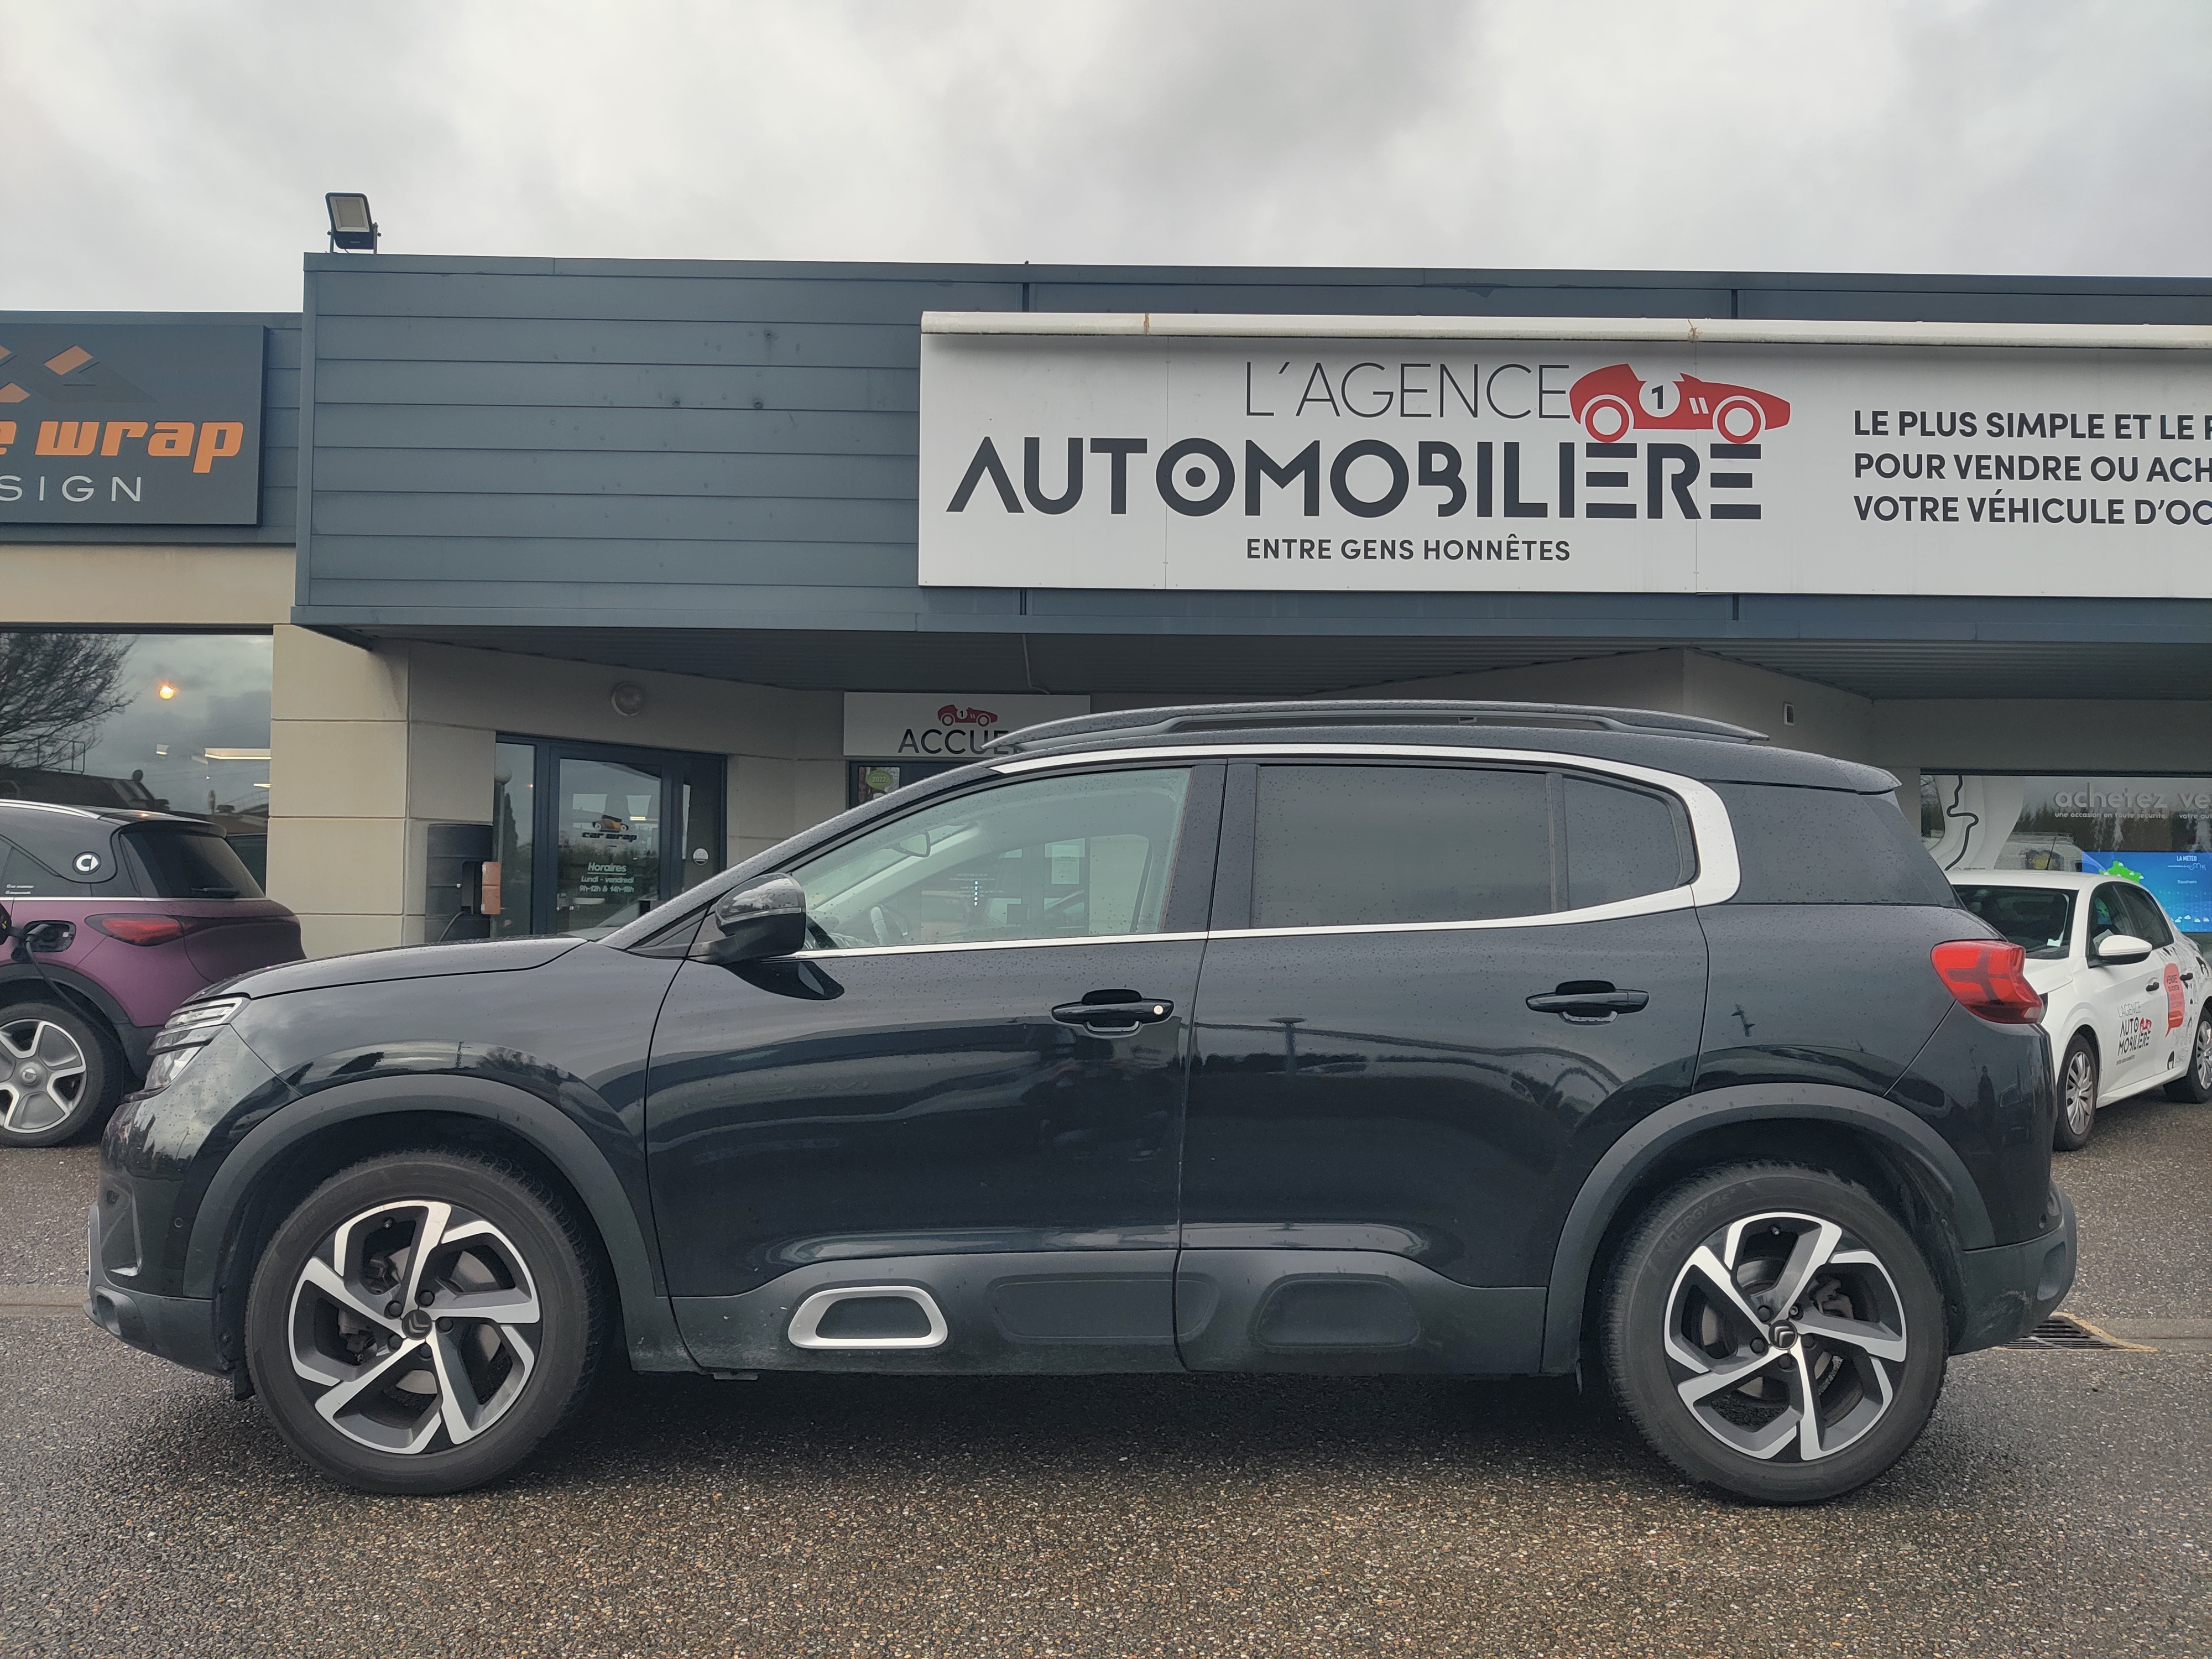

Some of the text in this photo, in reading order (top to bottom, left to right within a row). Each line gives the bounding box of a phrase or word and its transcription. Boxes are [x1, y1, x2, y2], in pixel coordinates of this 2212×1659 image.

[1246, 361, 1571, 419] L'AGENCE
[1651, 384, 1664, 410] 1
[1854, 410, 1888, 436] LE
[1899, 411, 1978, 437] PLUS
[1986, 412, 2105, 439] SIMPLE
[2115, 414, 2152, 440] ET
[2160, 415, 2194, 440] LE
[35, 421, 244, 473] wrap
[1855, 453, 2212, 482] POUR VENDRE OU ACH
[1854, 495, 1959, 521] VOTRE
[1966, 489, 2125, 524] VÉHICULE
[1246, 533, 1571, 561] ENTRE GENS HONNÊTES
[2054, 782, 2168, 808] achetez
[2115, 810, 2134, 818] toute
[587, 862, 627, 872] Horaires
[2116, 1001, 2141, 1018] L'AGENCE
[2119, 1016, 2139, 1037] AUTO
